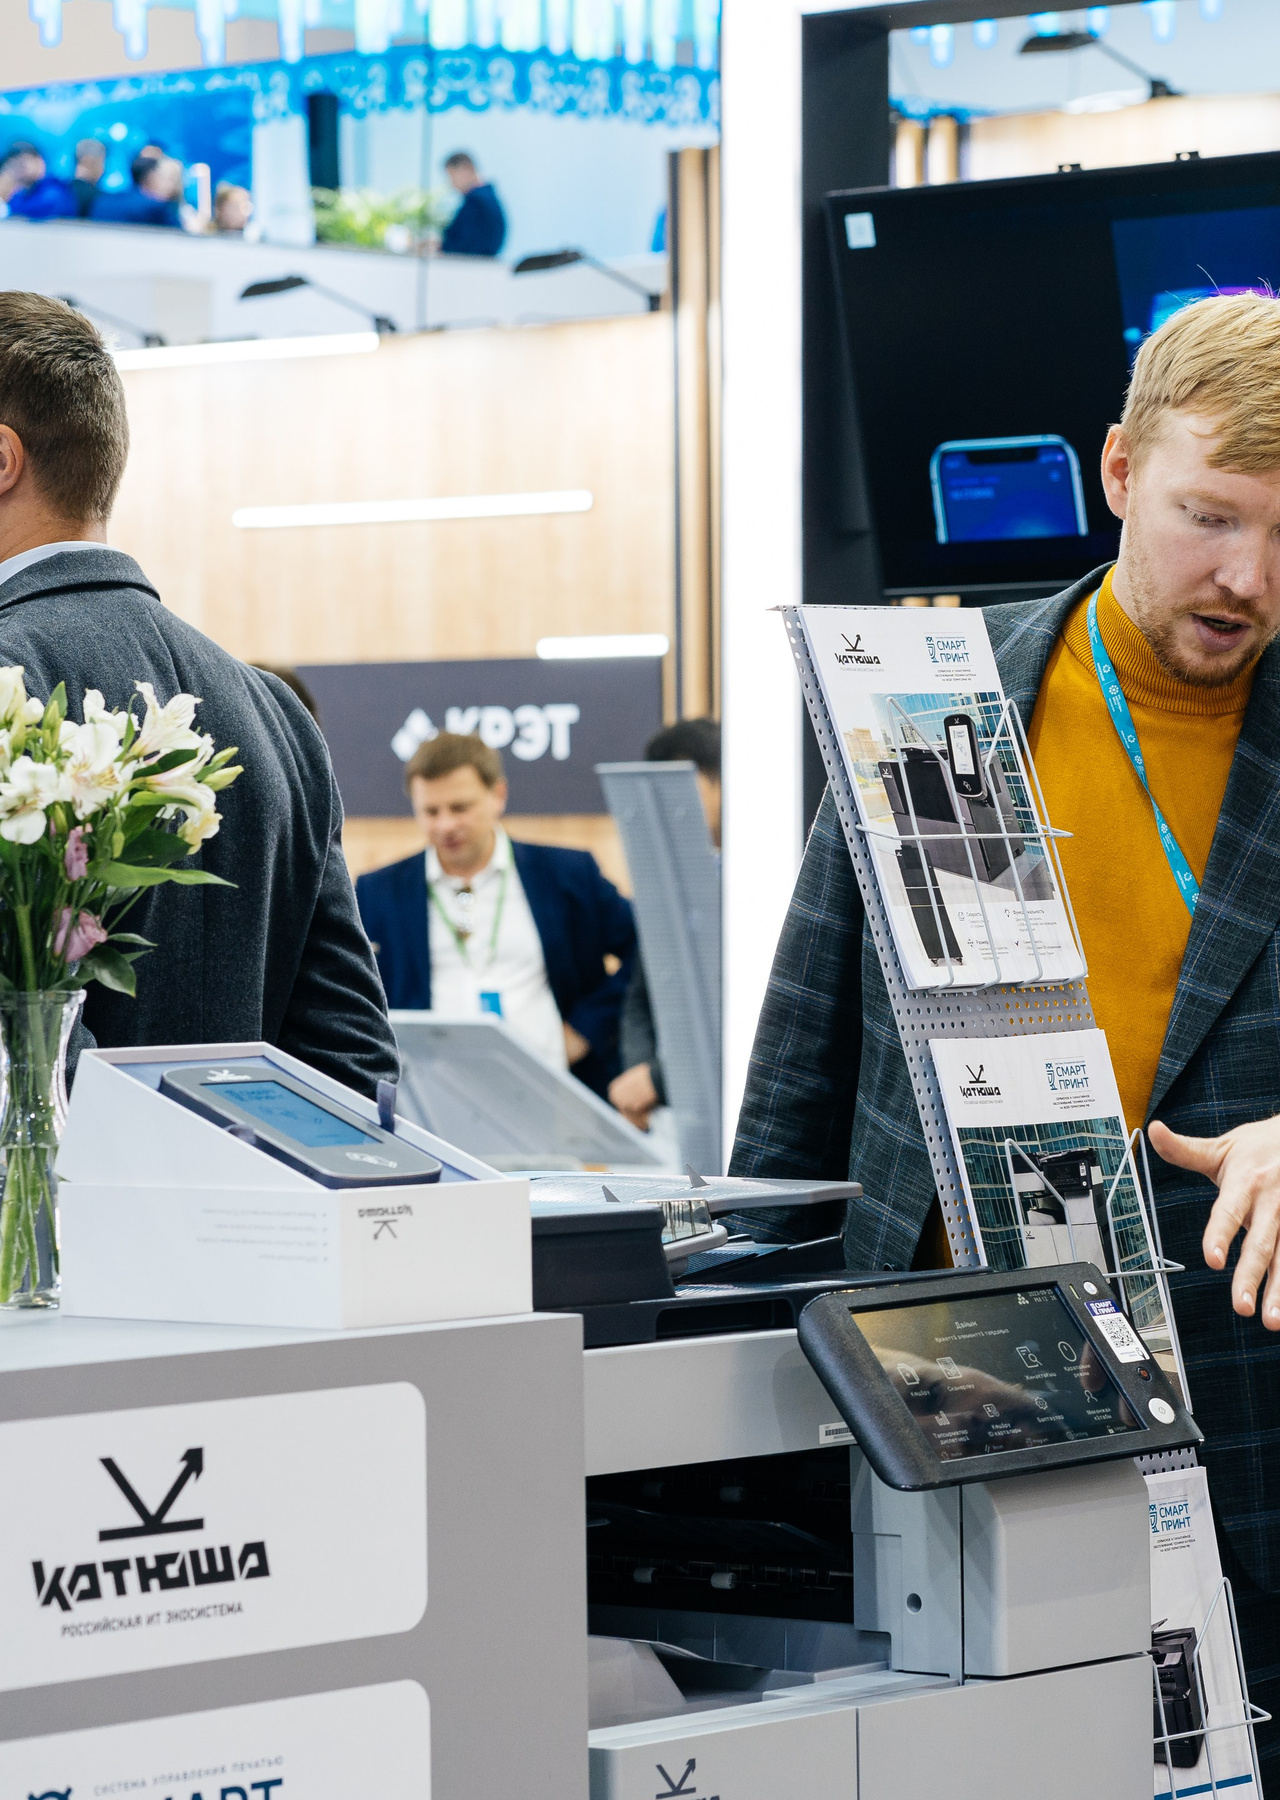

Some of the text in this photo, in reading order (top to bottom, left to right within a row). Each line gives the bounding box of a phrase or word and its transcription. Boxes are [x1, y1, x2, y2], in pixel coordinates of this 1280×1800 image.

[936, 640, 966, 650] СМАРТ
[940, 653, 969, 662] ПРИНТ
[1056, 1065, 1086, 1077] СМАРТ
[1059, 1077, 1089, 1090] ПРИНТ
[1159, 1504, 1188, 1518] СМАРТ
[1161, 1517, 1190, 1531] ПРИНТ
[60, 1600, 244, 1638] РОССИЙСКАЯ ИТ ЭКОСИСТЕМА
[94, 1778, 148, 1797] СИСТЕМА
[152, 1764, 227, 1786] УПРАВЛЕНИЯ
[232, 1754, 284, 1774] ПЕЧАТЬЮ
